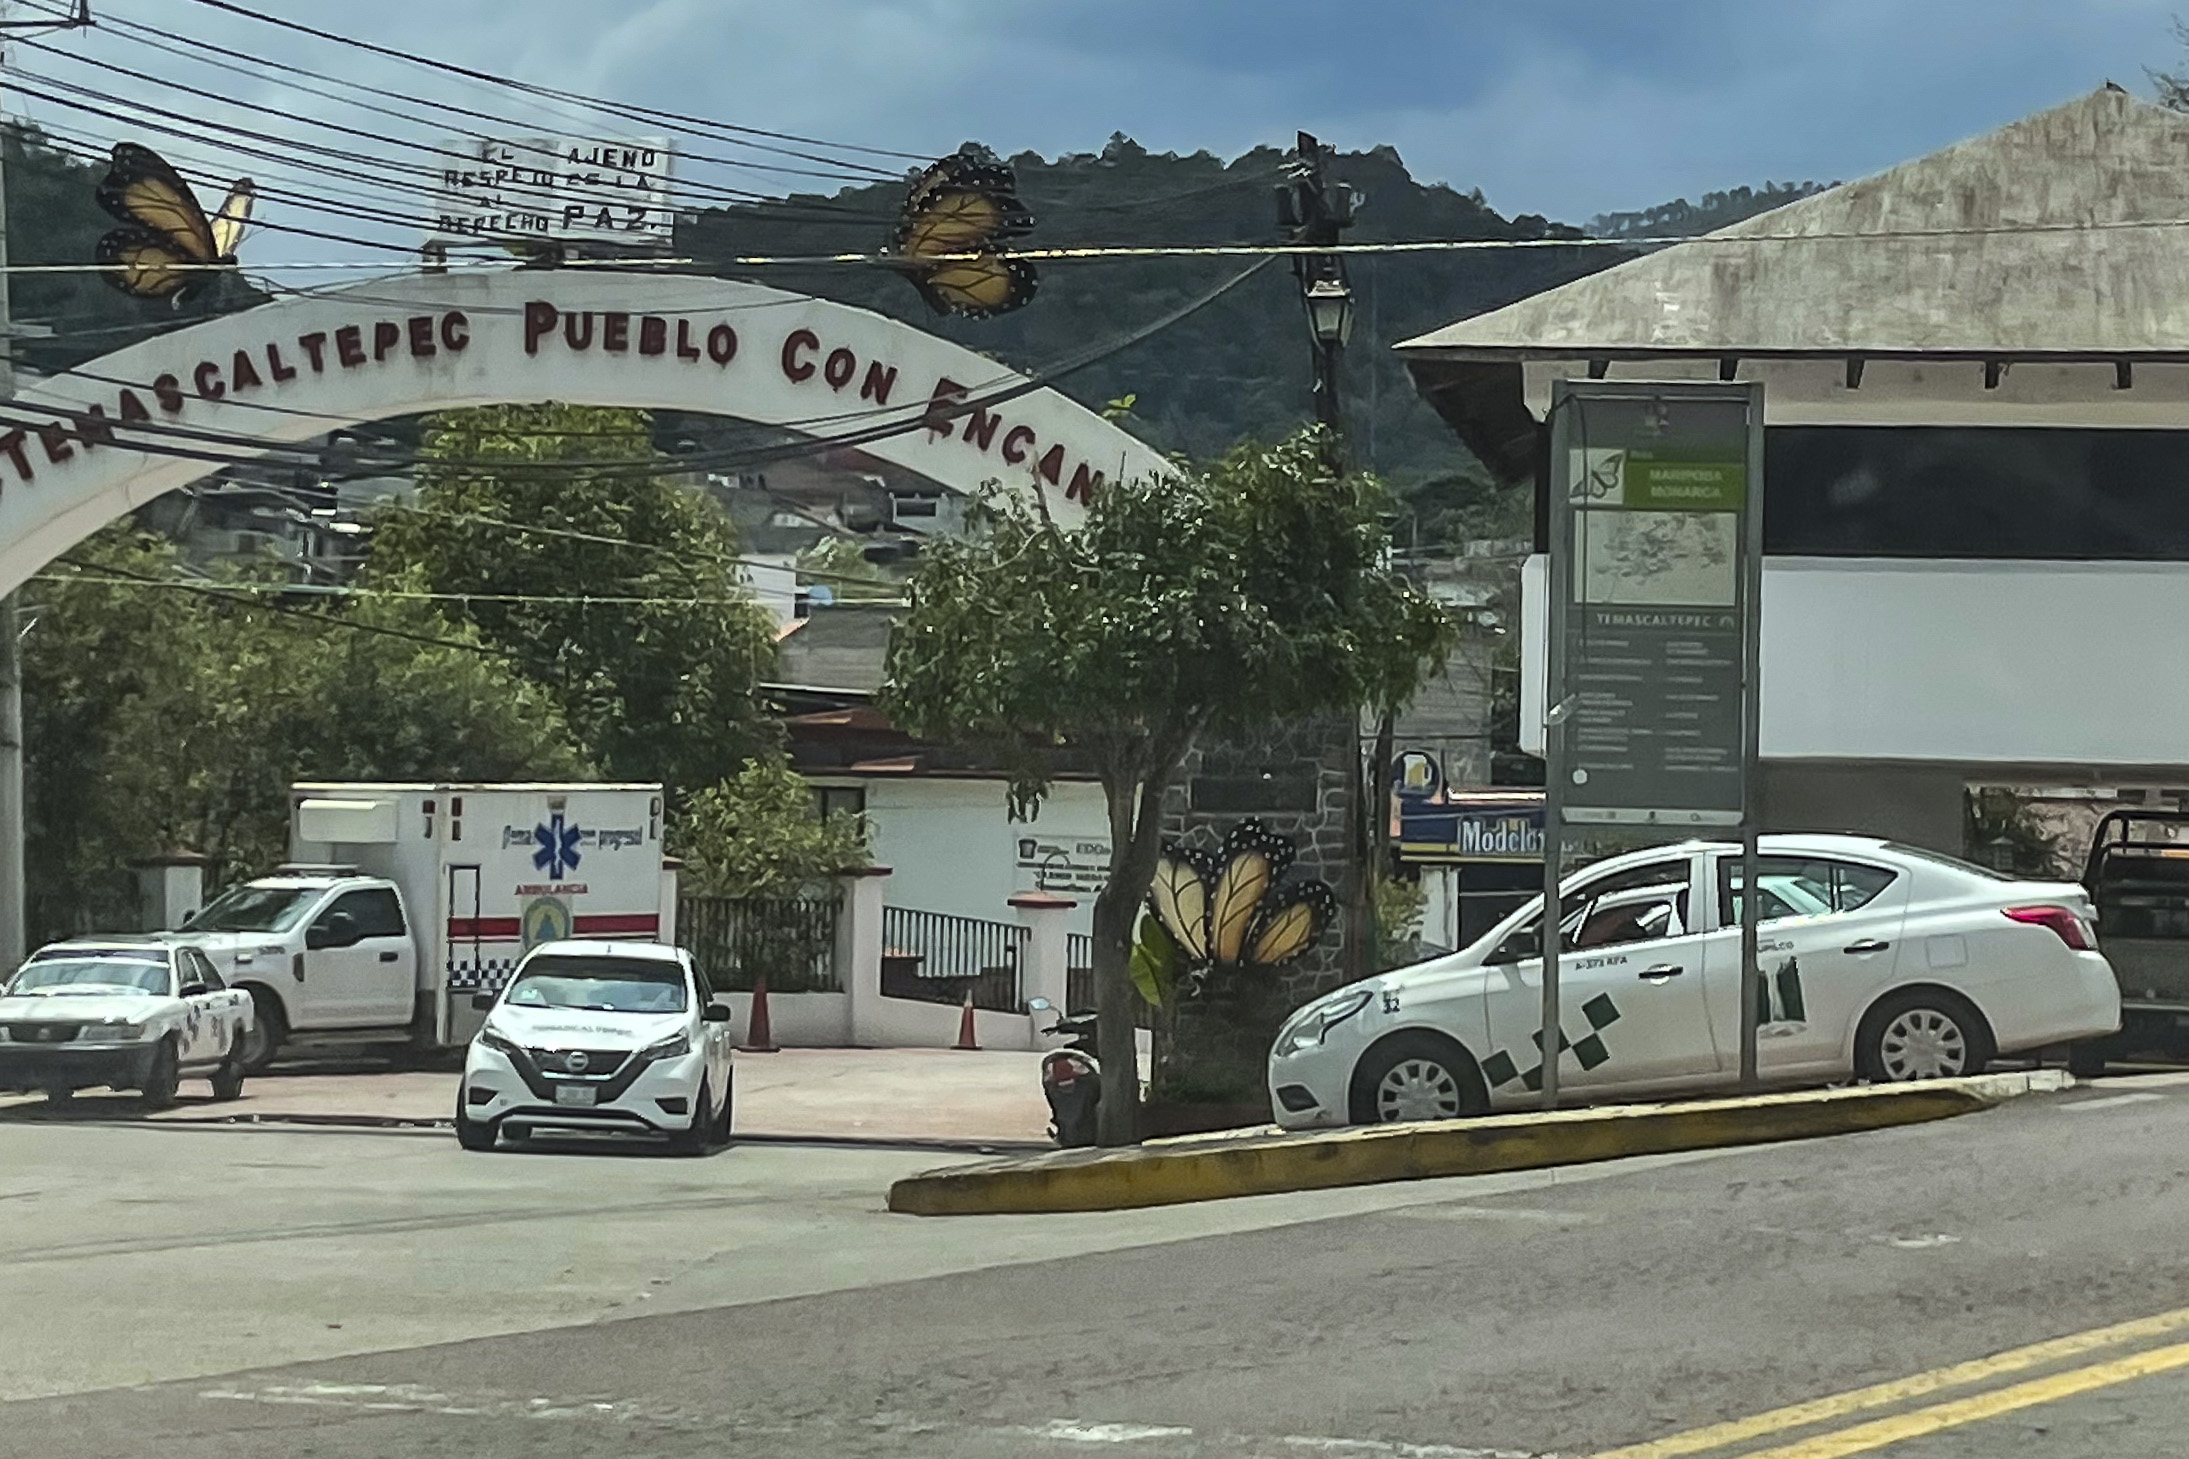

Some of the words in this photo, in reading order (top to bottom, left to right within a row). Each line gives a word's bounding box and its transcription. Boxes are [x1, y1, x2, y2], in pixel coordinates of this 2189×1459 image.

[568, 147, 655, 168] AJENO
[524, 301, 738, 364] PUEBLO
[781, 329, 898, 403] CON
[924, 376, 1106, 507] ENCAN
